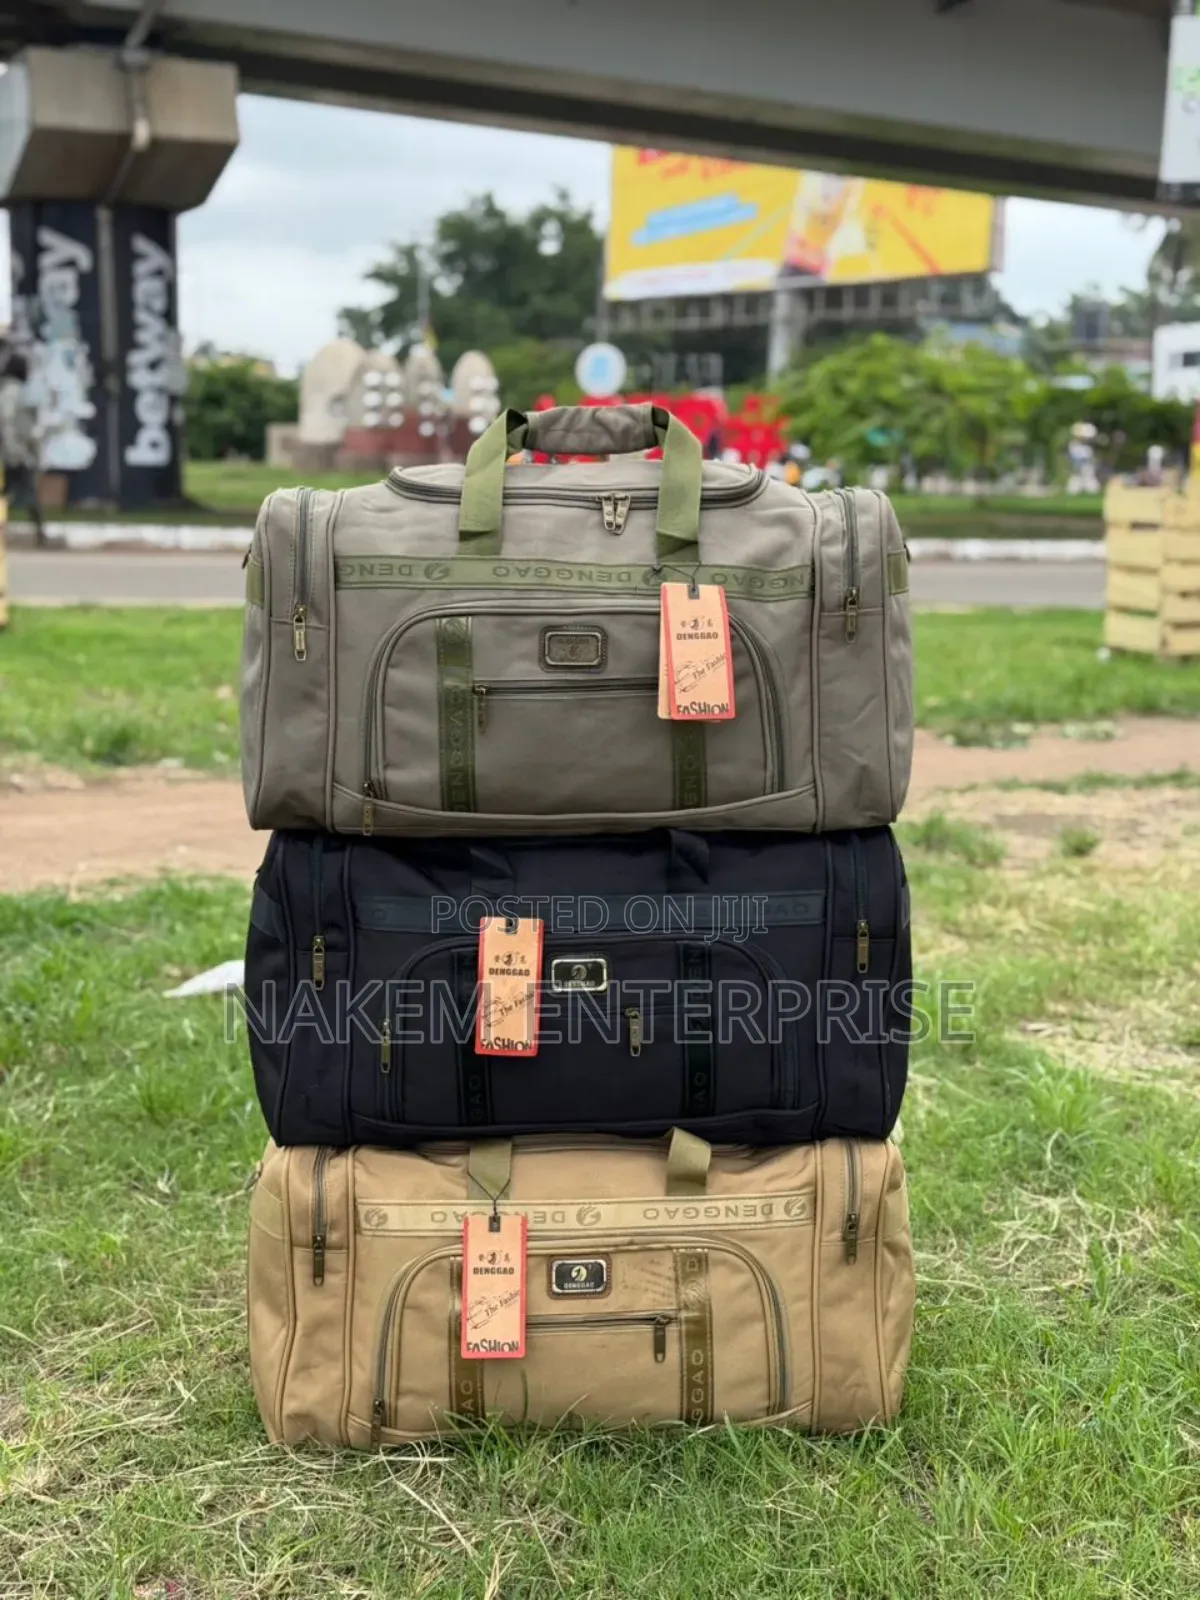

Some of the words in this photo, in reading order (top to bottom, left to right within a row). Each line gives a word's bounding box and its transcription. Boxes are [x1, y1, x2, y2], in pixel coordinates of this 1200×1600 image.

[122, 233, 173, 468] betway
[490, 565, 632, 584] DENGGAO
[676, 630, 719, 641] DENGGAO
[488, 966, 531, 978] DENGGAO
[642, 1202, 775, 1222] DENGGAO
[473, 1266, 515, 1276] DENGGAO
